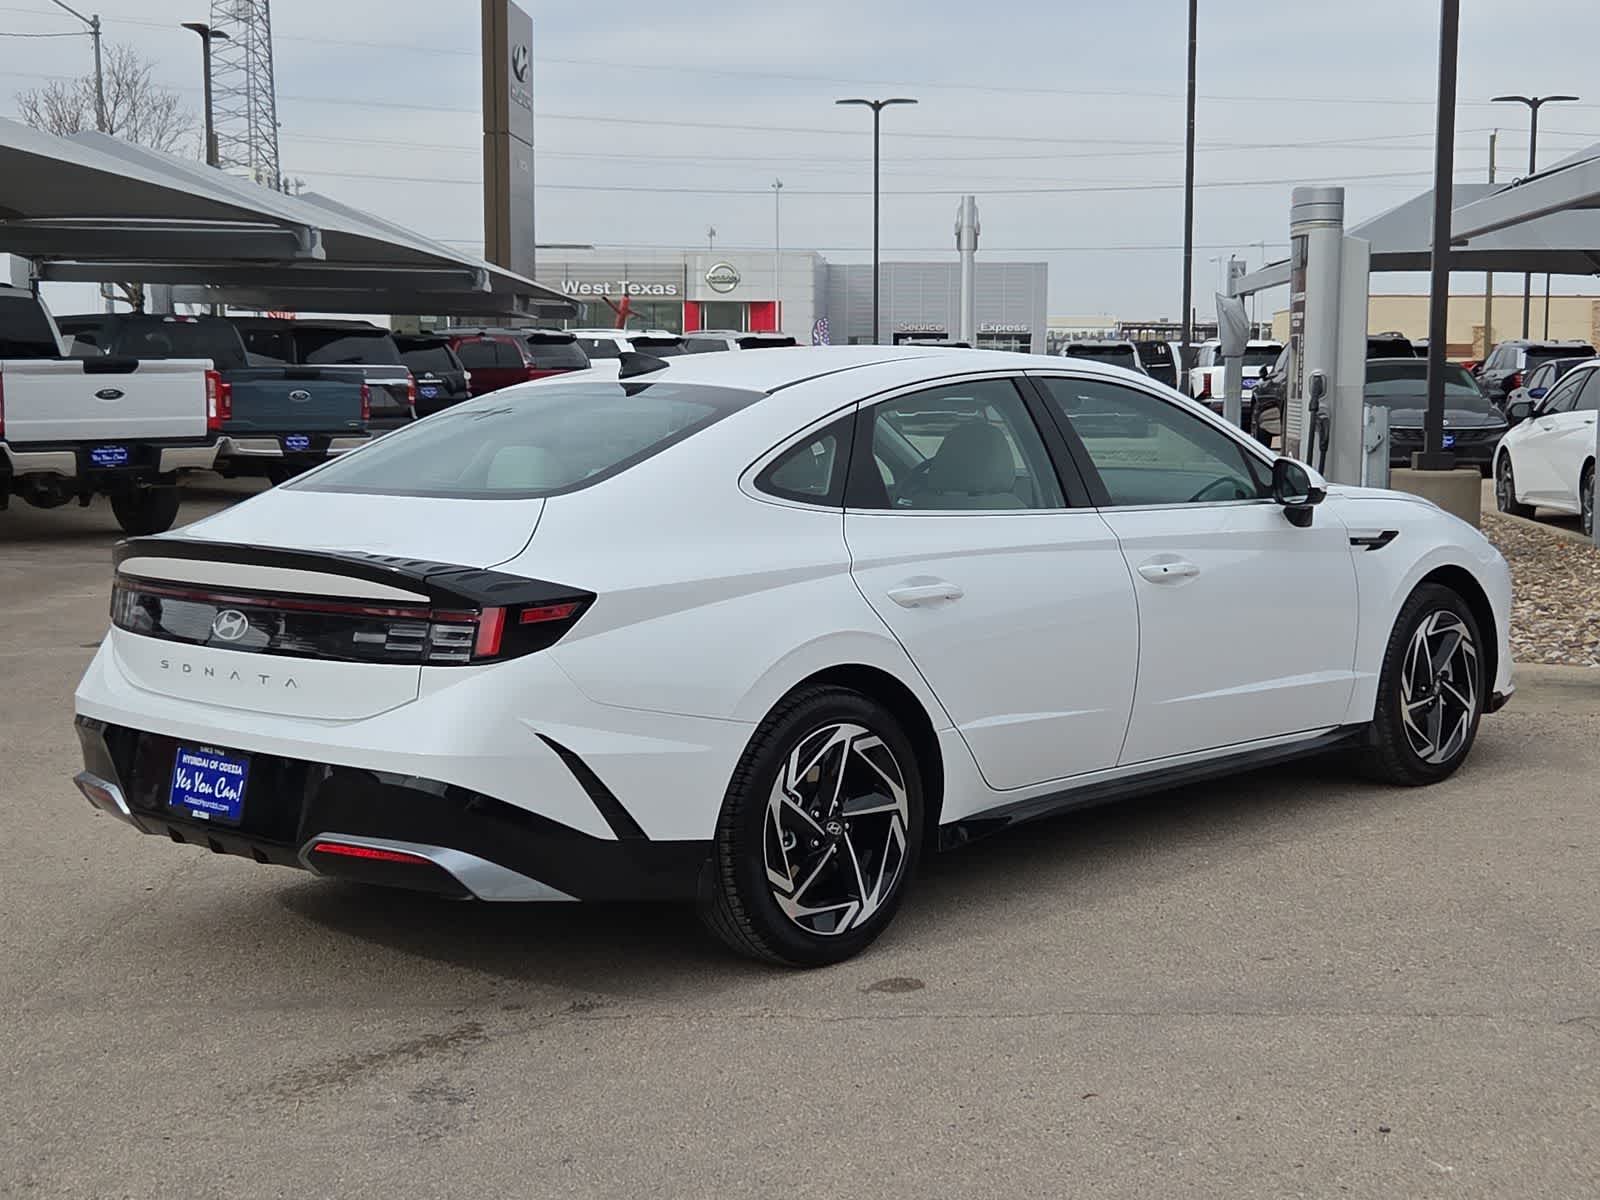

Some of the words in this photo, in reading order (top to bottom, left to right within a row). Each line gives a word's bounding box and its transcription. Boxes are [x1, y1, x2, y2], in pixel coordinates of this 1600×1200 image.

[561, 280, 610, 295] West
[617, 280, 677, 295] Texas
[899, 322, 944, 332] Service
[980, 322, 1028, 333] Express
[160, 659, 298, 689] SONATA
[209, 759, 219, 770] OF
[175, 767, 192, 791] Yes
[194, 771, 213, 794] You
[214, 776, 244, 803] Can!
